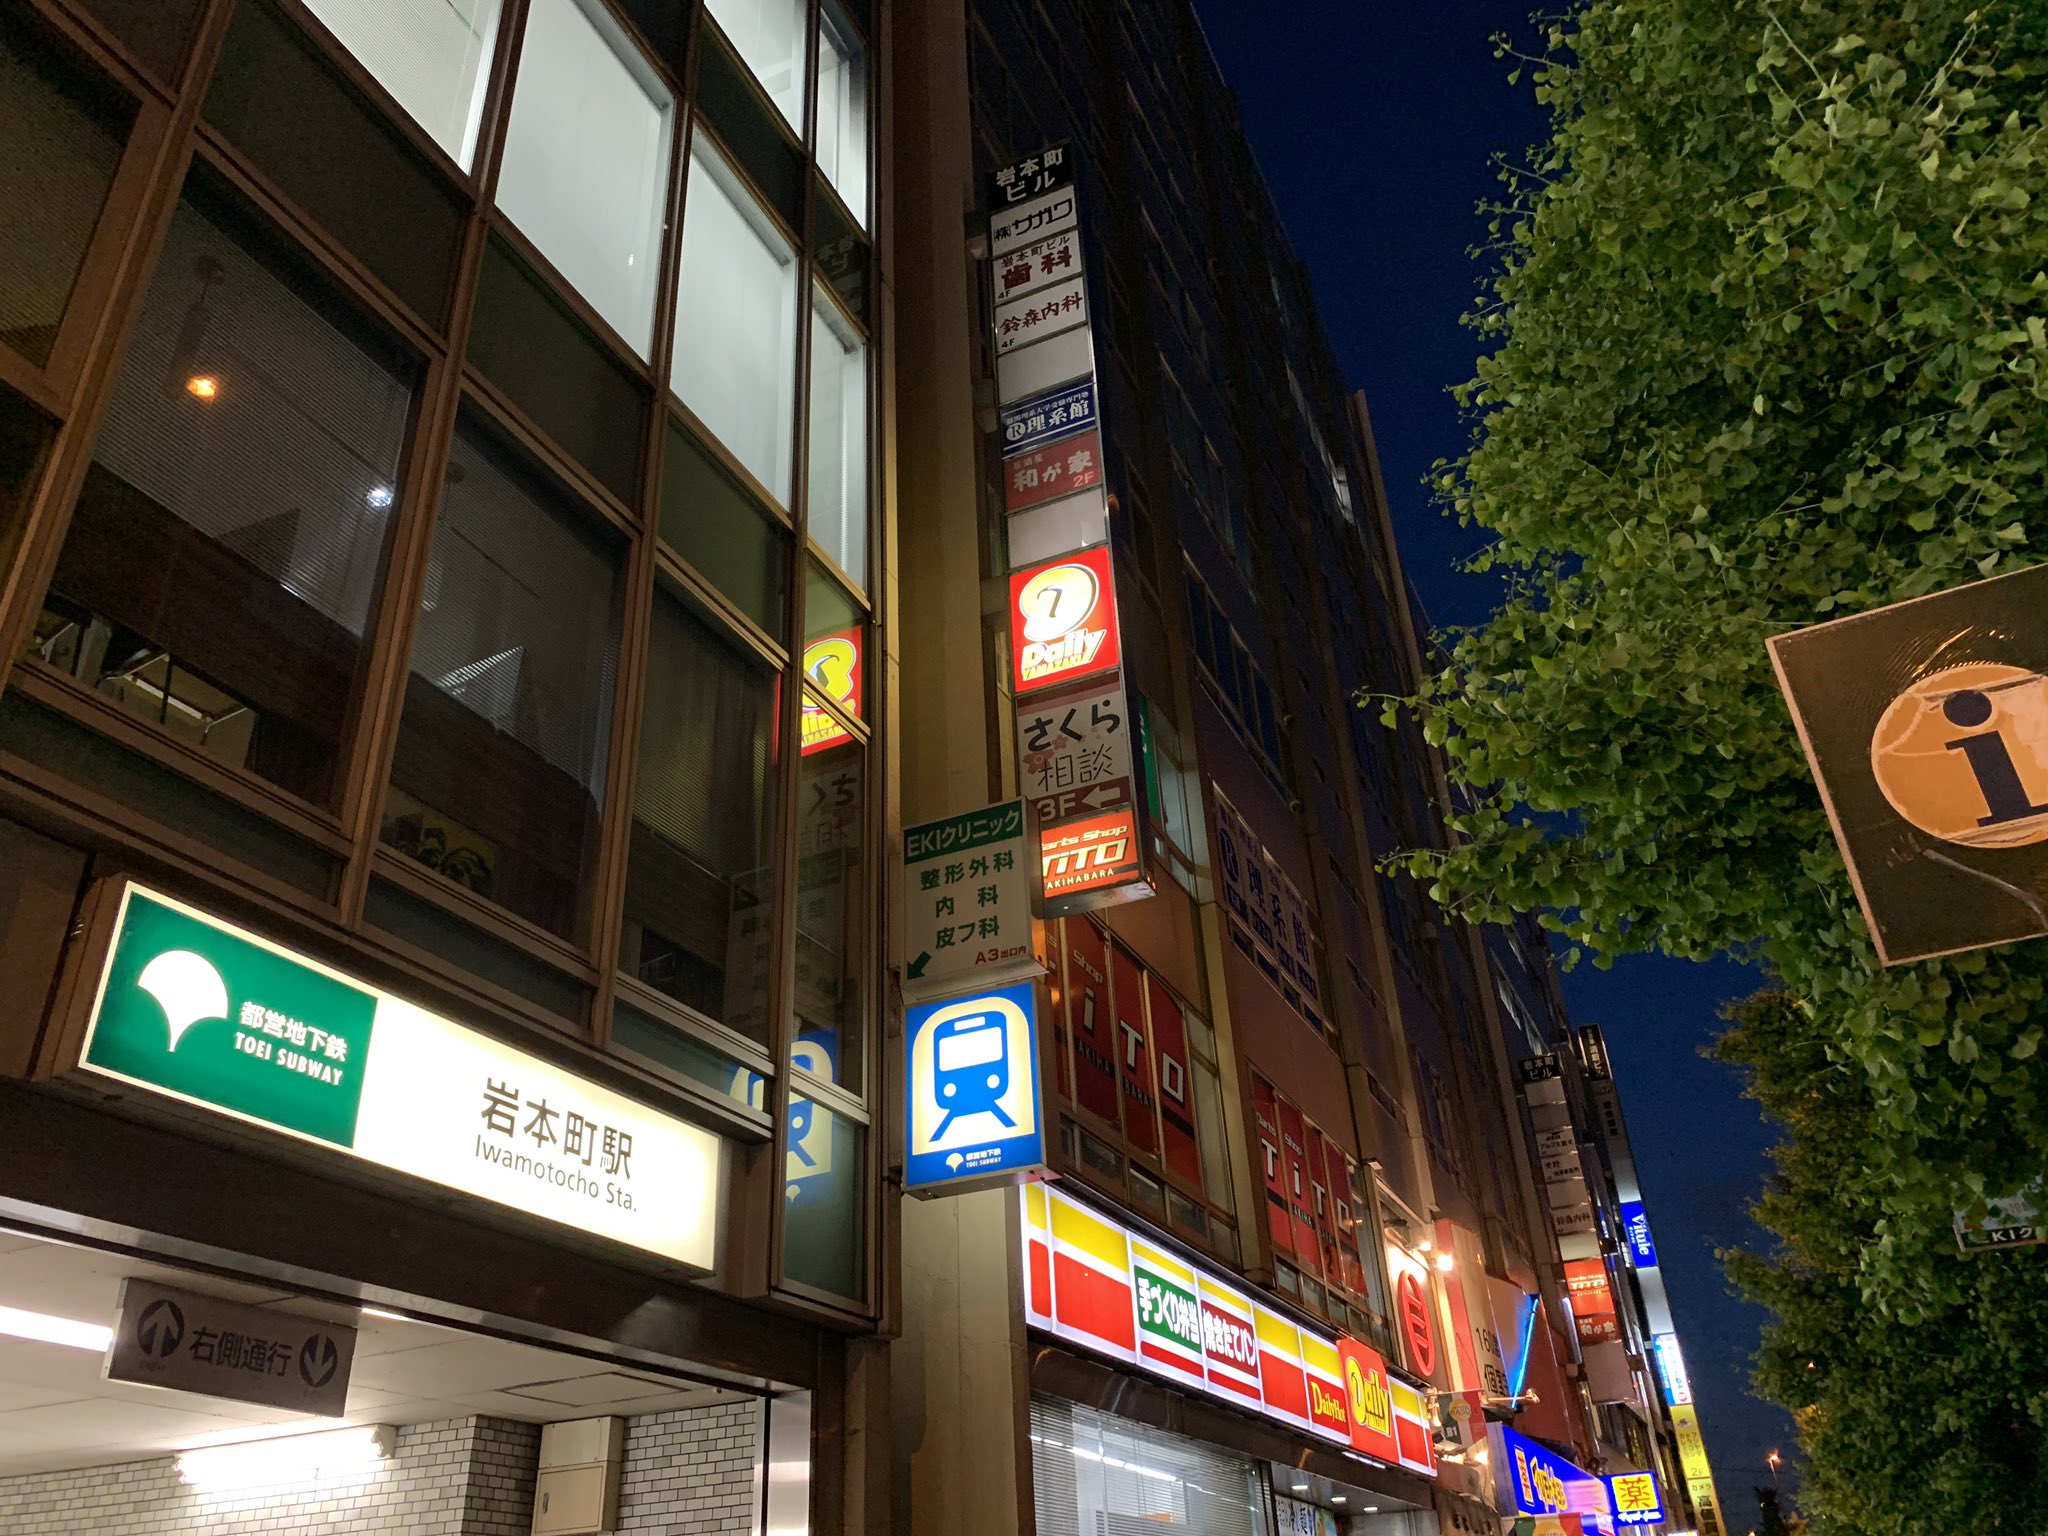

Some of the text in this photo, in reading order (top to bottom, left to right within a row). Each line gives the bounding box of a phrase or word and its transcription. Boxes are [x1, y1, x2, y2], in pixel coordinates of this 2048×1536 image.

[996, 148, 1063, 187] 岩本町
[1007, 174, 1055, 202] ビル
[1001, 245, 1072, 290] 歯科
[1000, 291, 1083, 335] 鈴森内科
[1014, 451, 1093, 491] 和が家
[1074, 472, 1095, 488] 2F
[1022, 627, 1107, 671] Daily
[1024, 699, 1121, 752] さくら
[1038, 743, 1114, 792] 相談
[1037, 793, 1077, 822] 3F
[907, 809, 1021, 858] EKIクリニック
[1042, 825, 1129, 850] arts Shop
[920, 849, 1015, 891] 整形外科
[1047, 867, 1115, 890] AKIHABARA
[935, 916, 1000, 950] 皮フ科
[1073, 949, 1104, 985] Shop
[240, 1000, 348, 1063] 都営地下鉄
[234, 1032, 344, 1086] TOEI SUBWAY
[480, 1076, 634, 1180] 岩本町駅
[475, 1134, 637, 1213] Iwamotocho Sta.
[1632, 1212, 1650, 1257] Vitule
[1138, 1277, 1200, 1345] 手づくり弁当
[189, 1326, 293, 1377] 右側通行
[1202, 1308, 1256, 1367] 焼きたてパン
[1347, 1356, 1391, 1437] Daily
[1618, 1477, 1651, 1508] 薬
